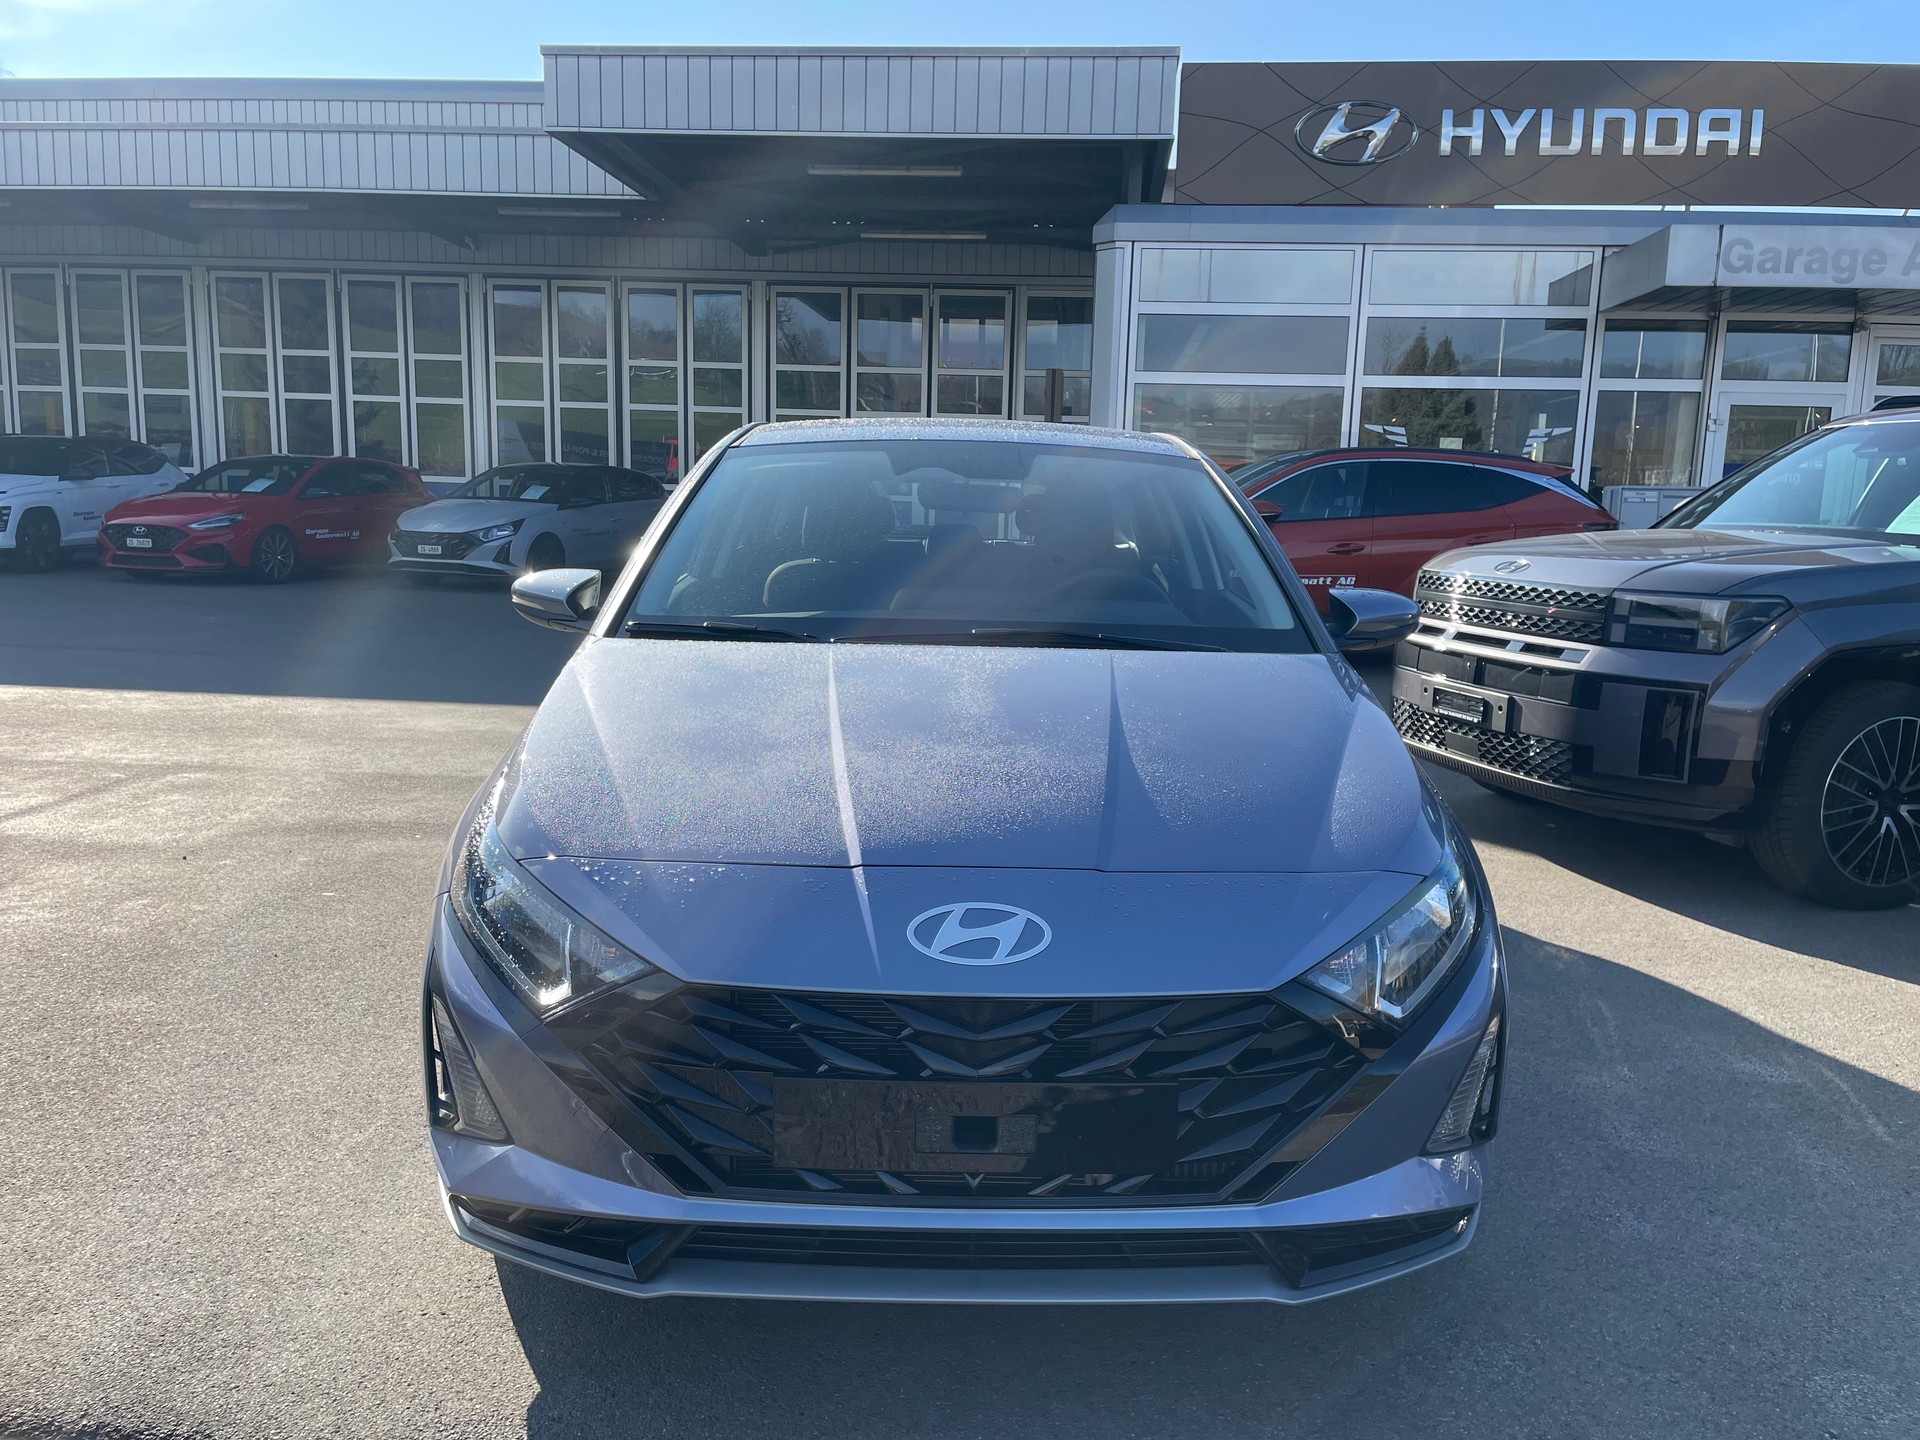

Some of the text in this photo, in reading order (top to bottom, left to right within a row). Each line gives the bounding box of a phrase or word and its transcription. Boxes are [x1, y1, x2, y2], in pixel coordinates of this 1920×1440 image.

[1439, 107, 1764, 158] HYUNDAI
[1721, 237, 1888, 284] Garage
[1336, 576, 1356, 585] AG
